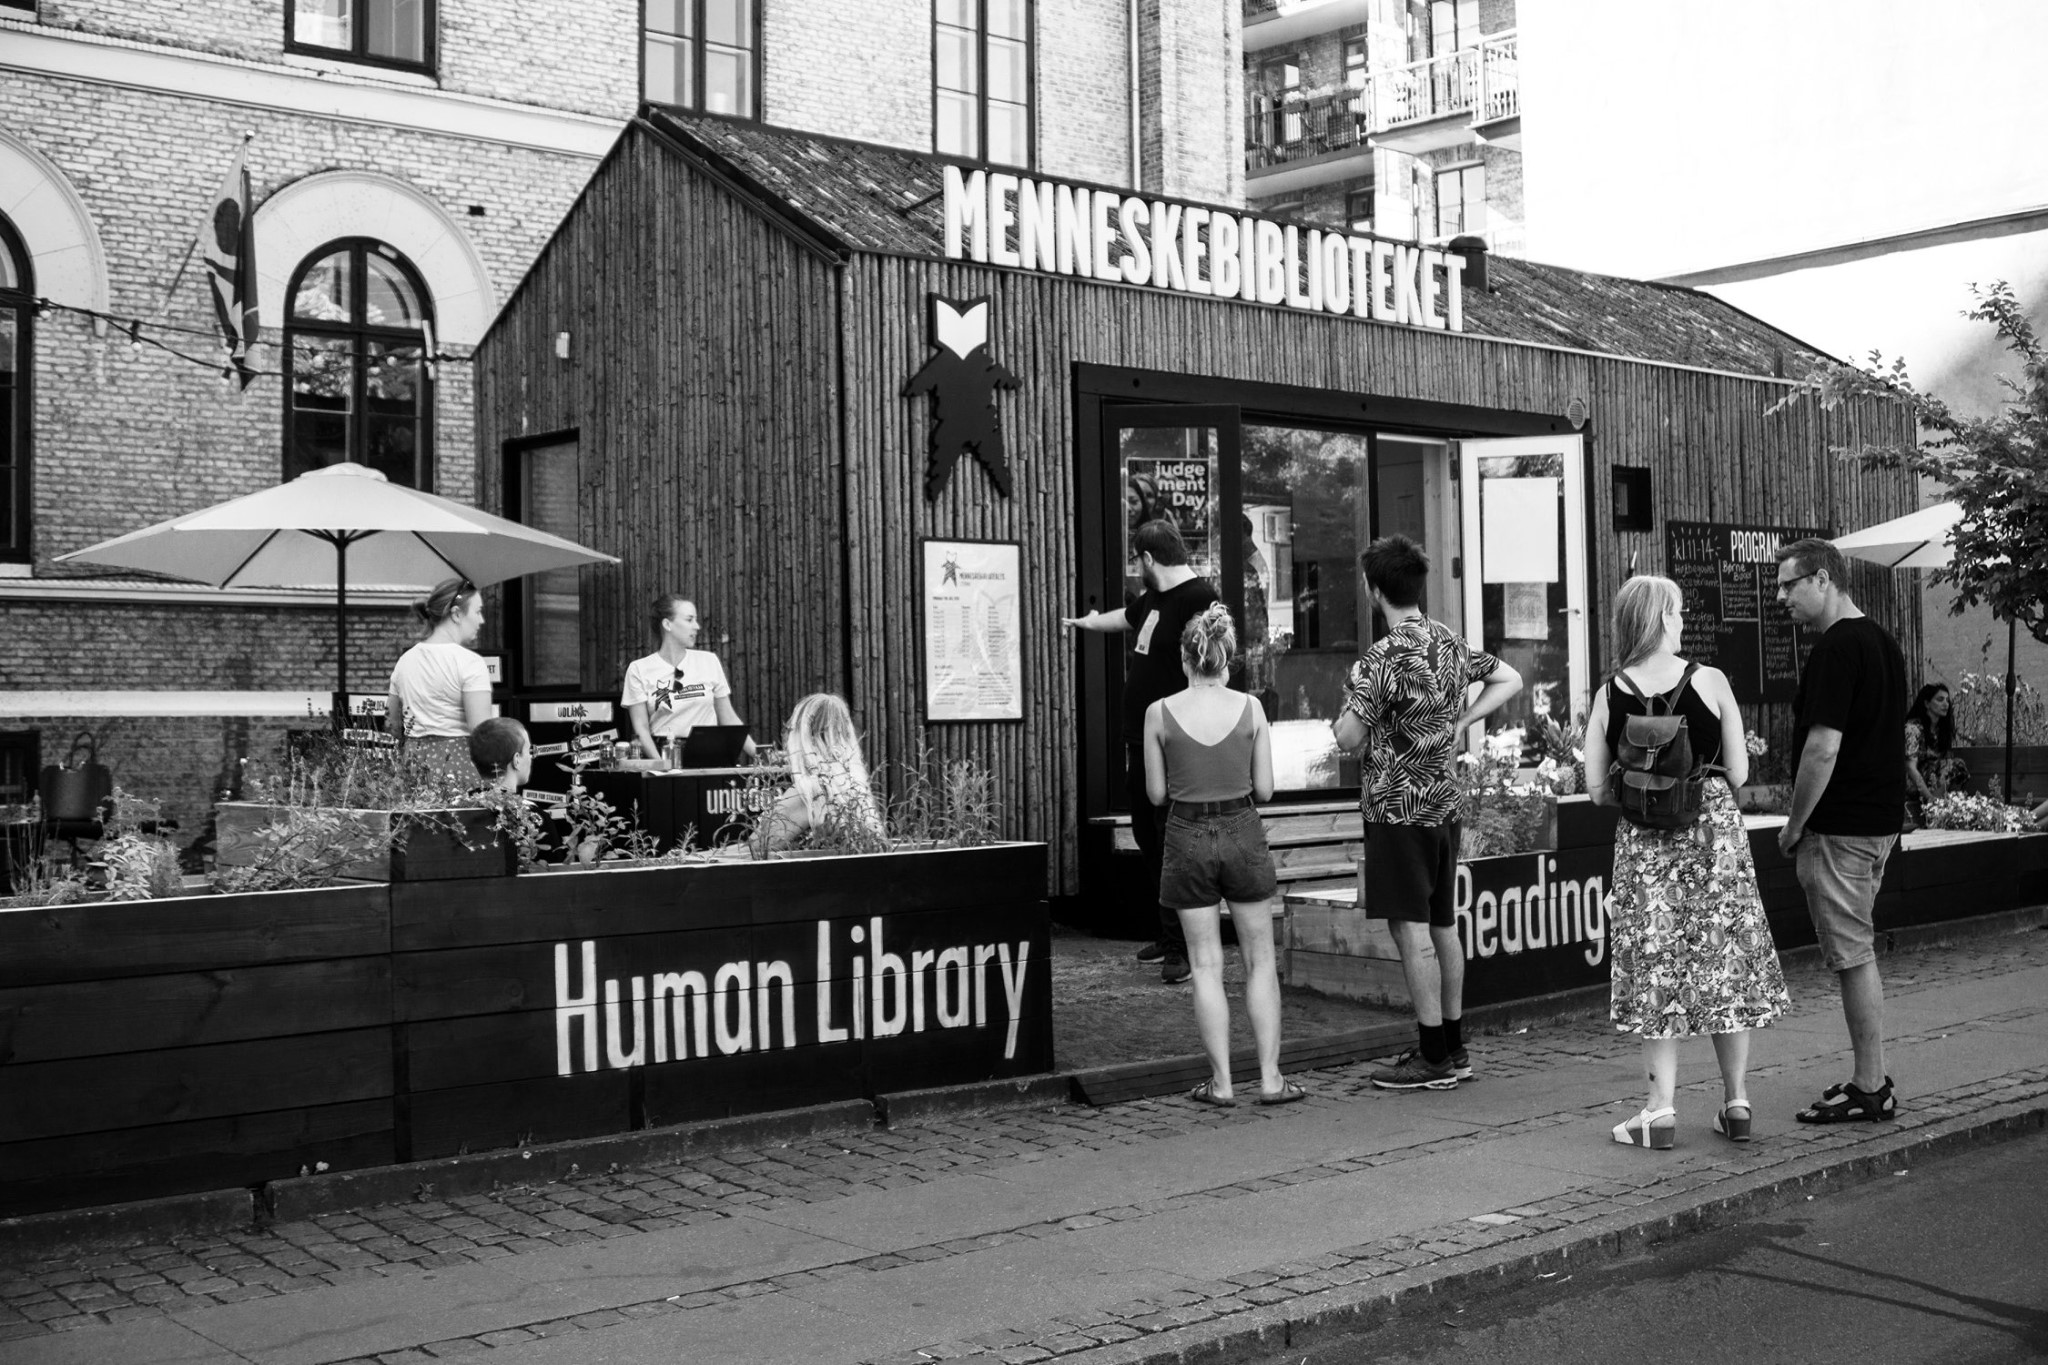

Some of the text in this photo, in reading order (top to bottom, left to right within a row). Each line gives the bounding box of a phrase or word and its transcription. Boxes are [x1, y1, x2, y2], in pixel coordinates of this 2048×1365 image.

[943, 165, 1467, 333] MENNESKEBIBLIOTEKET
[1154, 461, 1205, 479] judge
[1158, 477, 1206, 491] ment
[1172, 492, 1206, 510] Day
[1730, 530, 1779, 563] PROGRAM
[1454, 854, 1605, 967] Reading
[555, 916, 1030, 1077] Human Library
